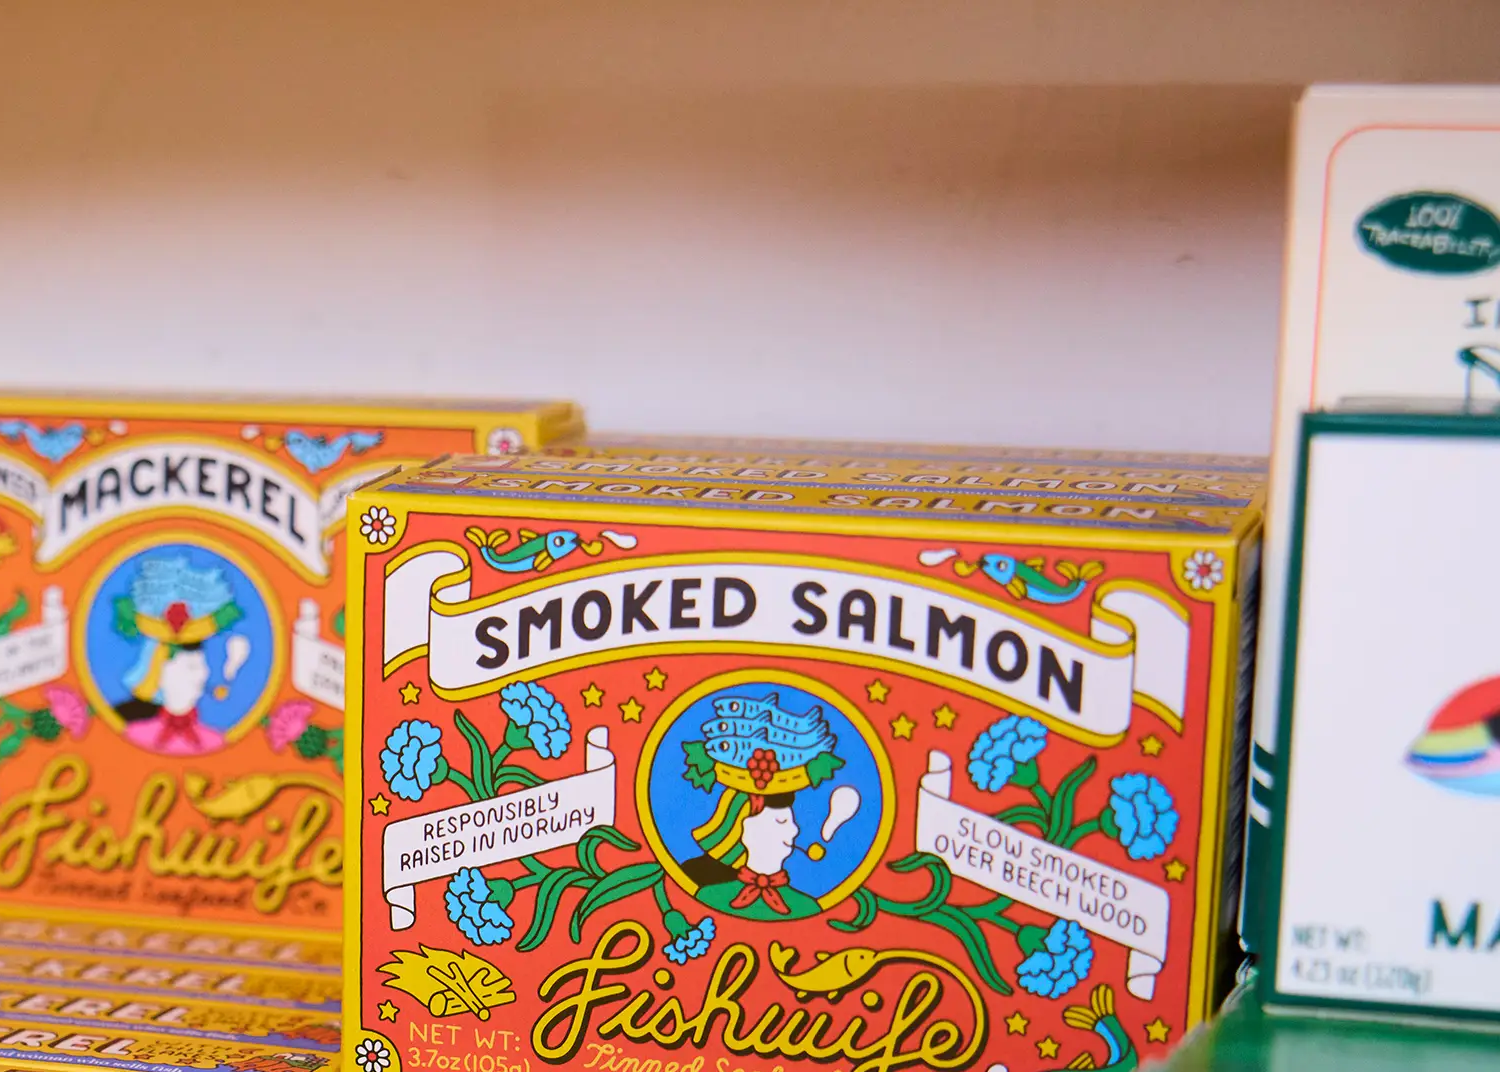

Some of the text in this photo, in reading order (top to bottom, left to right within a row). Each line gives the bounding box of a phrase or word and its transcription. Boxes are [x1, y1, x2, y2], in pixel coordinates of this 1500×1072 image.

[59, 456, 305, 543] MACKEREL
[475, 576, 1085, 714] SMOKED SALMON
[399, 805, 596, 872] RAISED IN NORWAY
[423, 791, 560, 842] RESPONSIBLY
[935, 835, 1147, 936] OVER BEECH WOOD
[958, 817, 1128, 901] SLOW SMOKED
[408, 1022, 521, 1054] NET WT:
